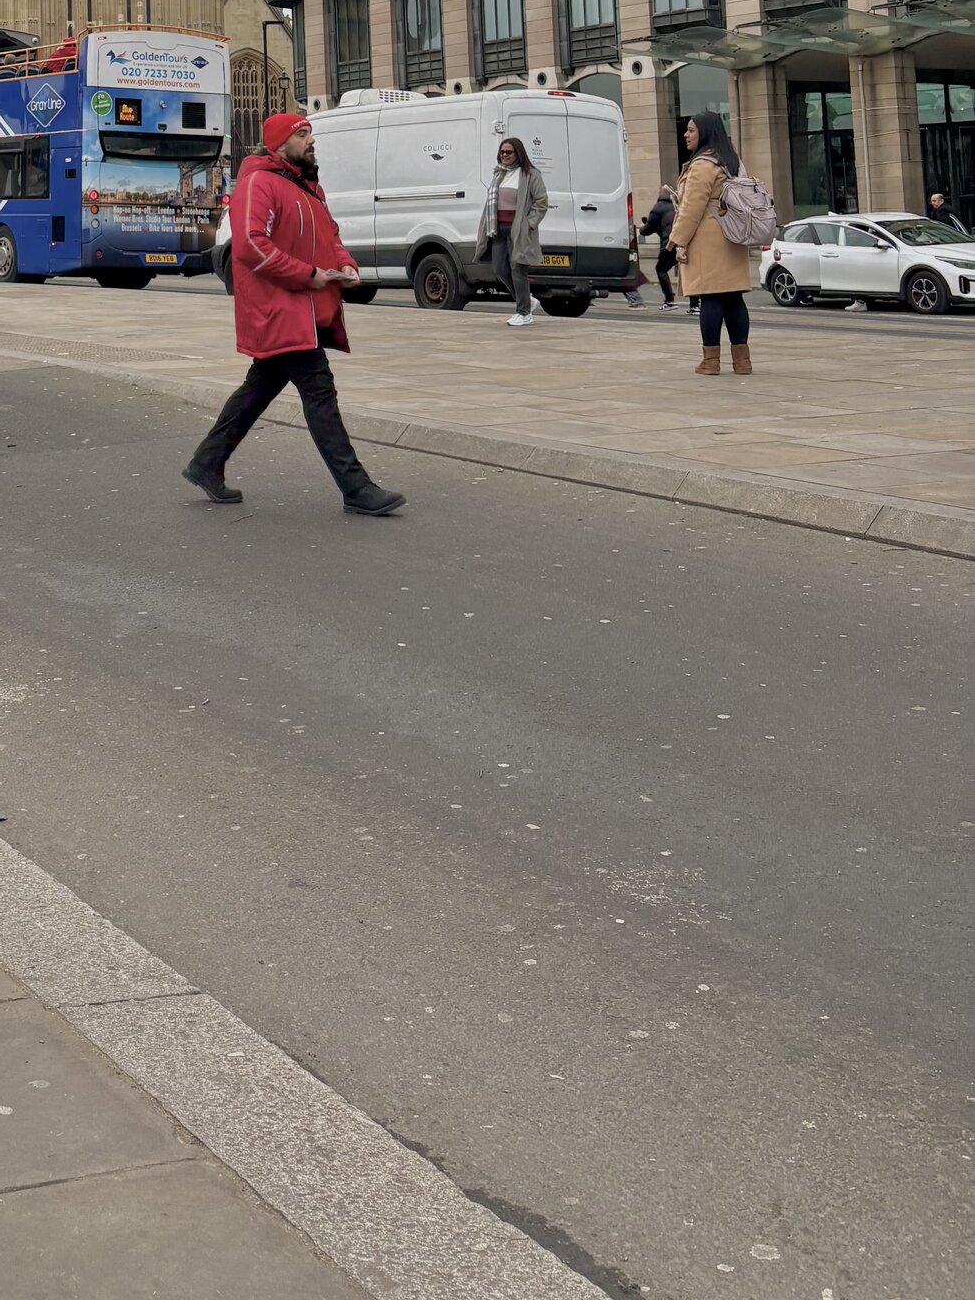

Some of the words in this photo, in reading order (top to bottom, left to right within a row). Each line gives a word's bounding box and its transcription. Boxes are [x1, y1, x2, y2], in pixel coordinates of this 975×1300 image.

[121, 67, 142, 77] 020
[145, 68, 168, 78] 7233
[171, 70, 196, 80] 7030
[117, 77, 201, 89] www.goldentours.com
[423, 143, 452, 152] COLICCI
[112, 205, 131, 214] Hop-on
[131, 205, 151, 215] Hop-off
[157, 206, 175, 215] London
[113, 214, 131, 222] Warner
[145, 215, 161, 223] Studio
[162, 215, 172, 223] Tour
[173, 216, 191, 224] London
[197, 216, 210, 224] Paris
[121, 224, 143, 232] Brussels
[149, 224, 160, 232] Bike
[161, 224, 173, 232] Tours
[174, 224, 184, 232] and
